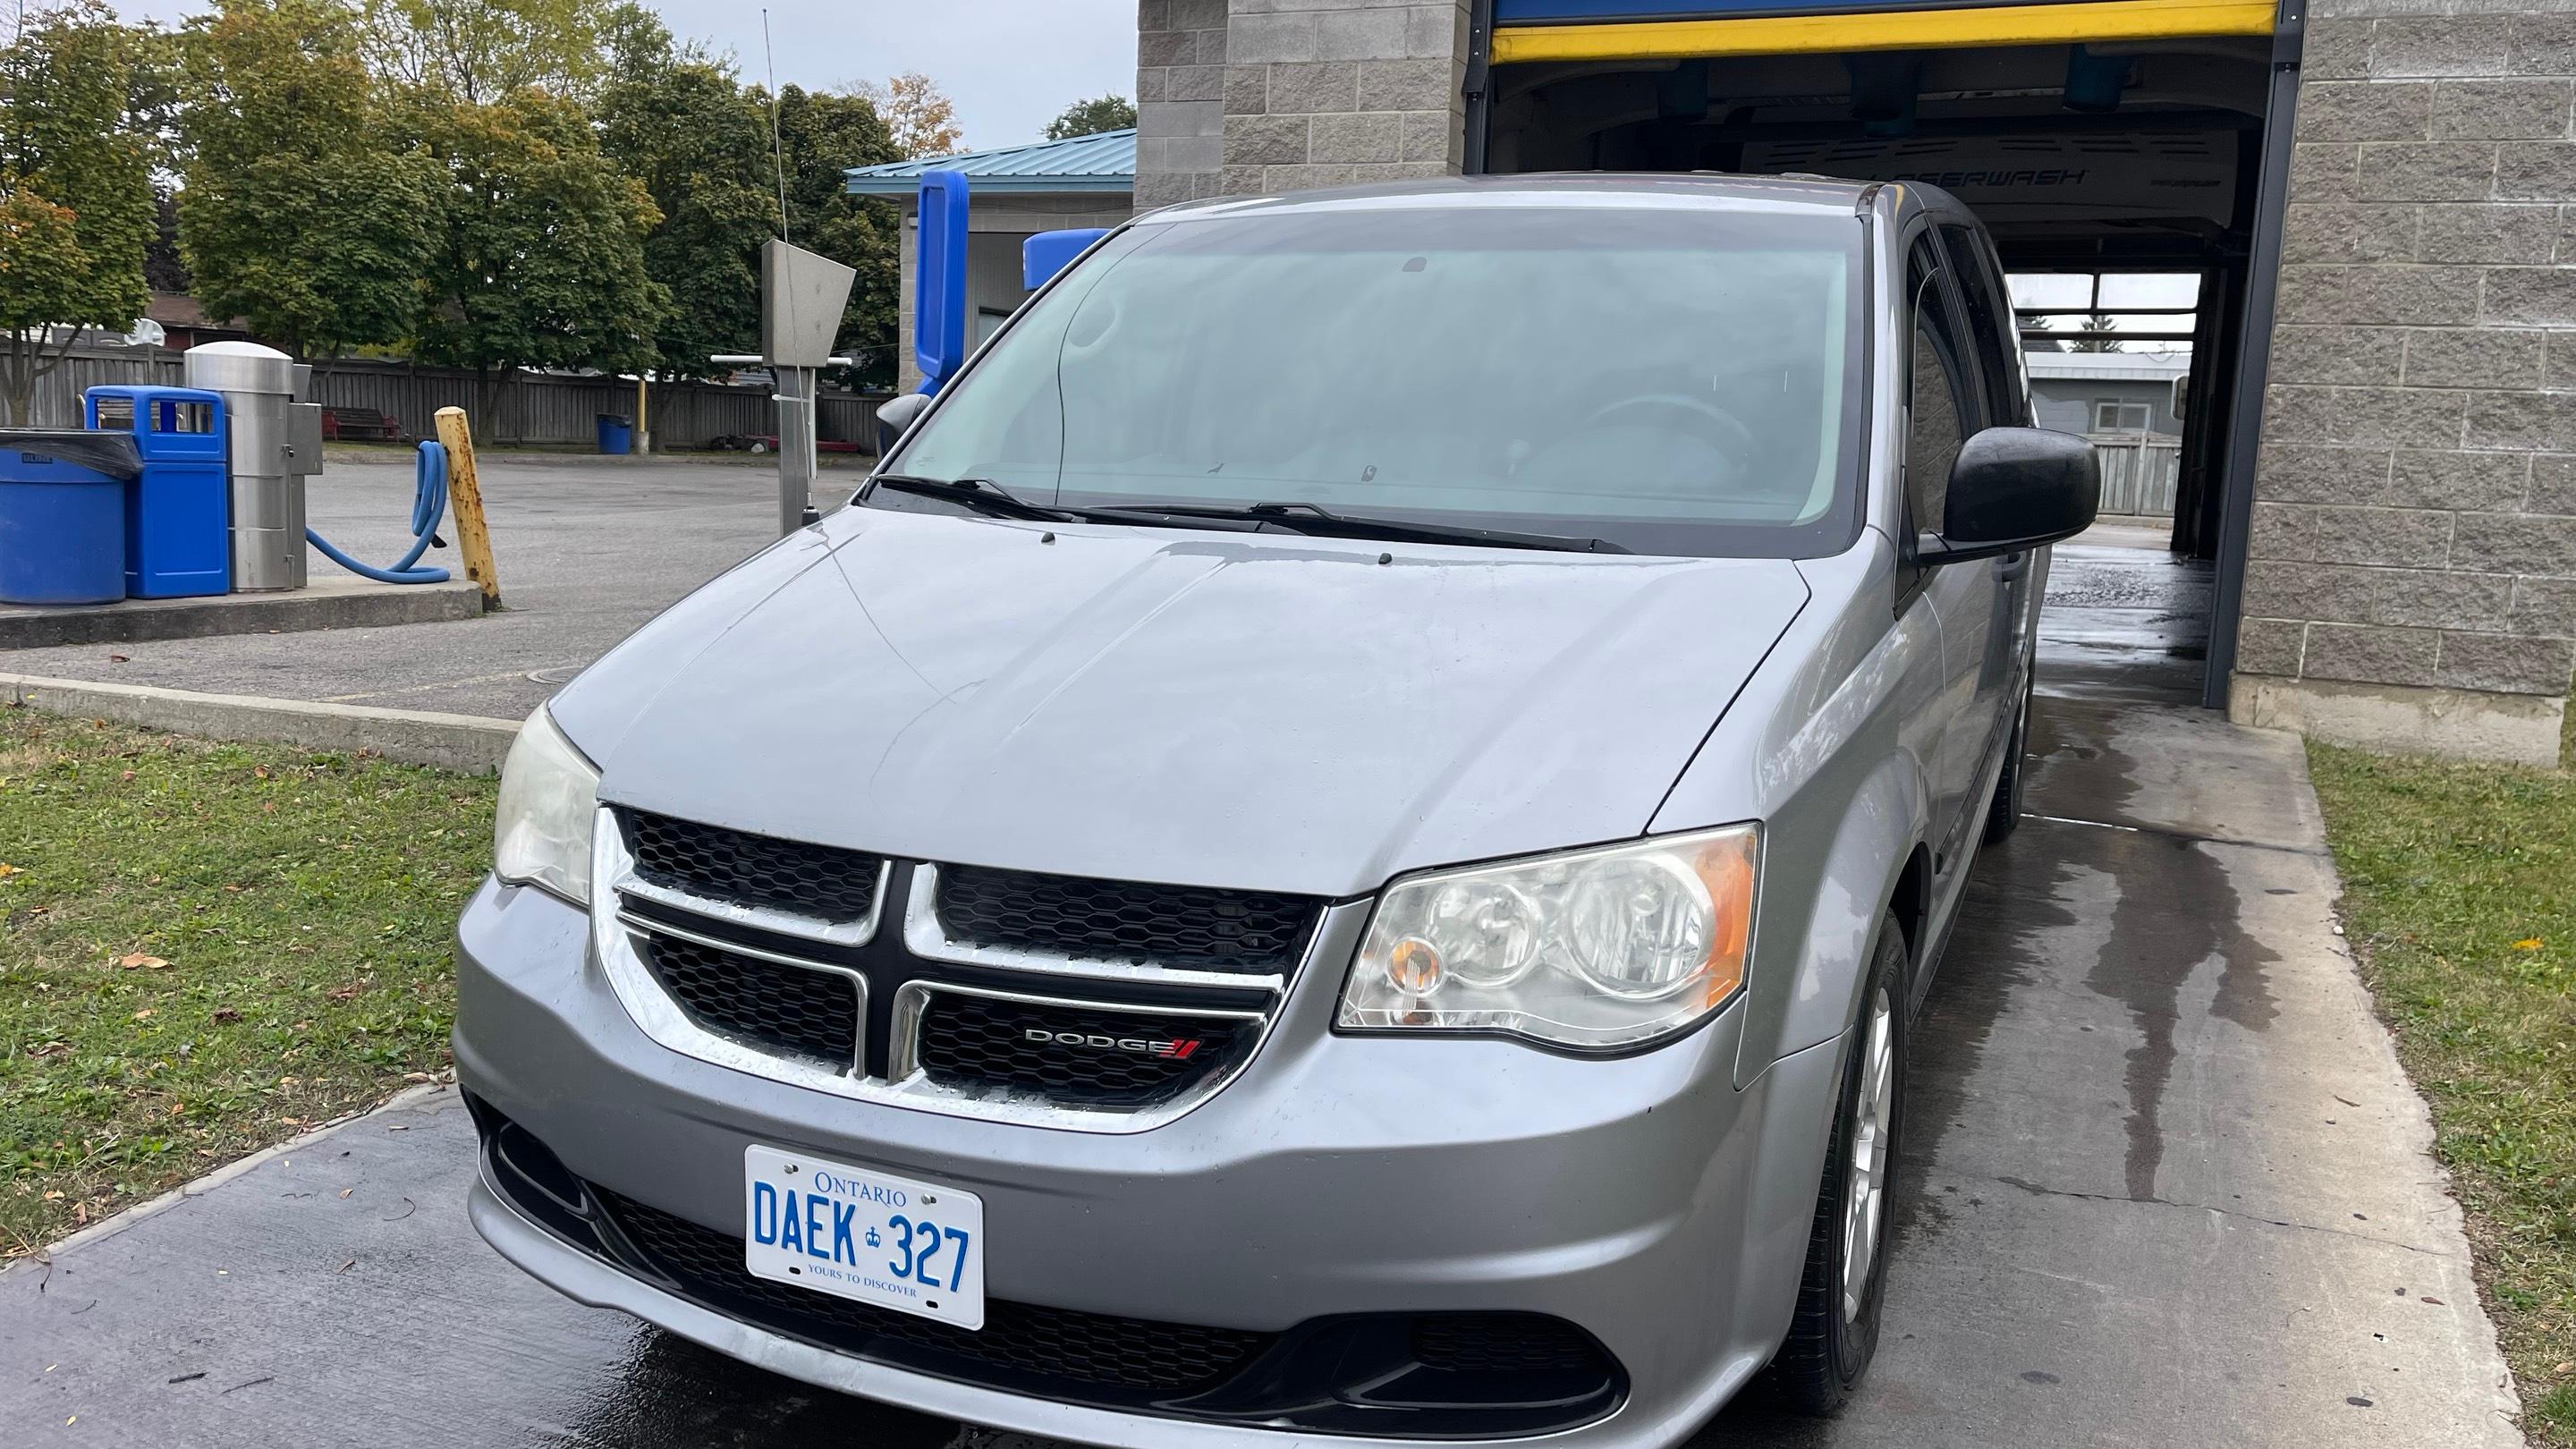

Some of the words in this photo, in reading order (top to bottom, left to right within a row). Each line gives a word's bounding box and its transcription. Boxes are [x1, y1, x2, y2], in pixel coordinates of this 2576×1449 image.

[1025, 1029, 1175, 1054] DODGE
[815, 1172, 907, 1208] ONTARIO
[754, 1181, 856, 1267] DAEK
[888, 1215, 969, 1293] 327
[808, 1264, 842, 1279] YOURS
[846, 1273, 860, 1284] TO
[864, 1278, 917, 1297] DISCOVER
